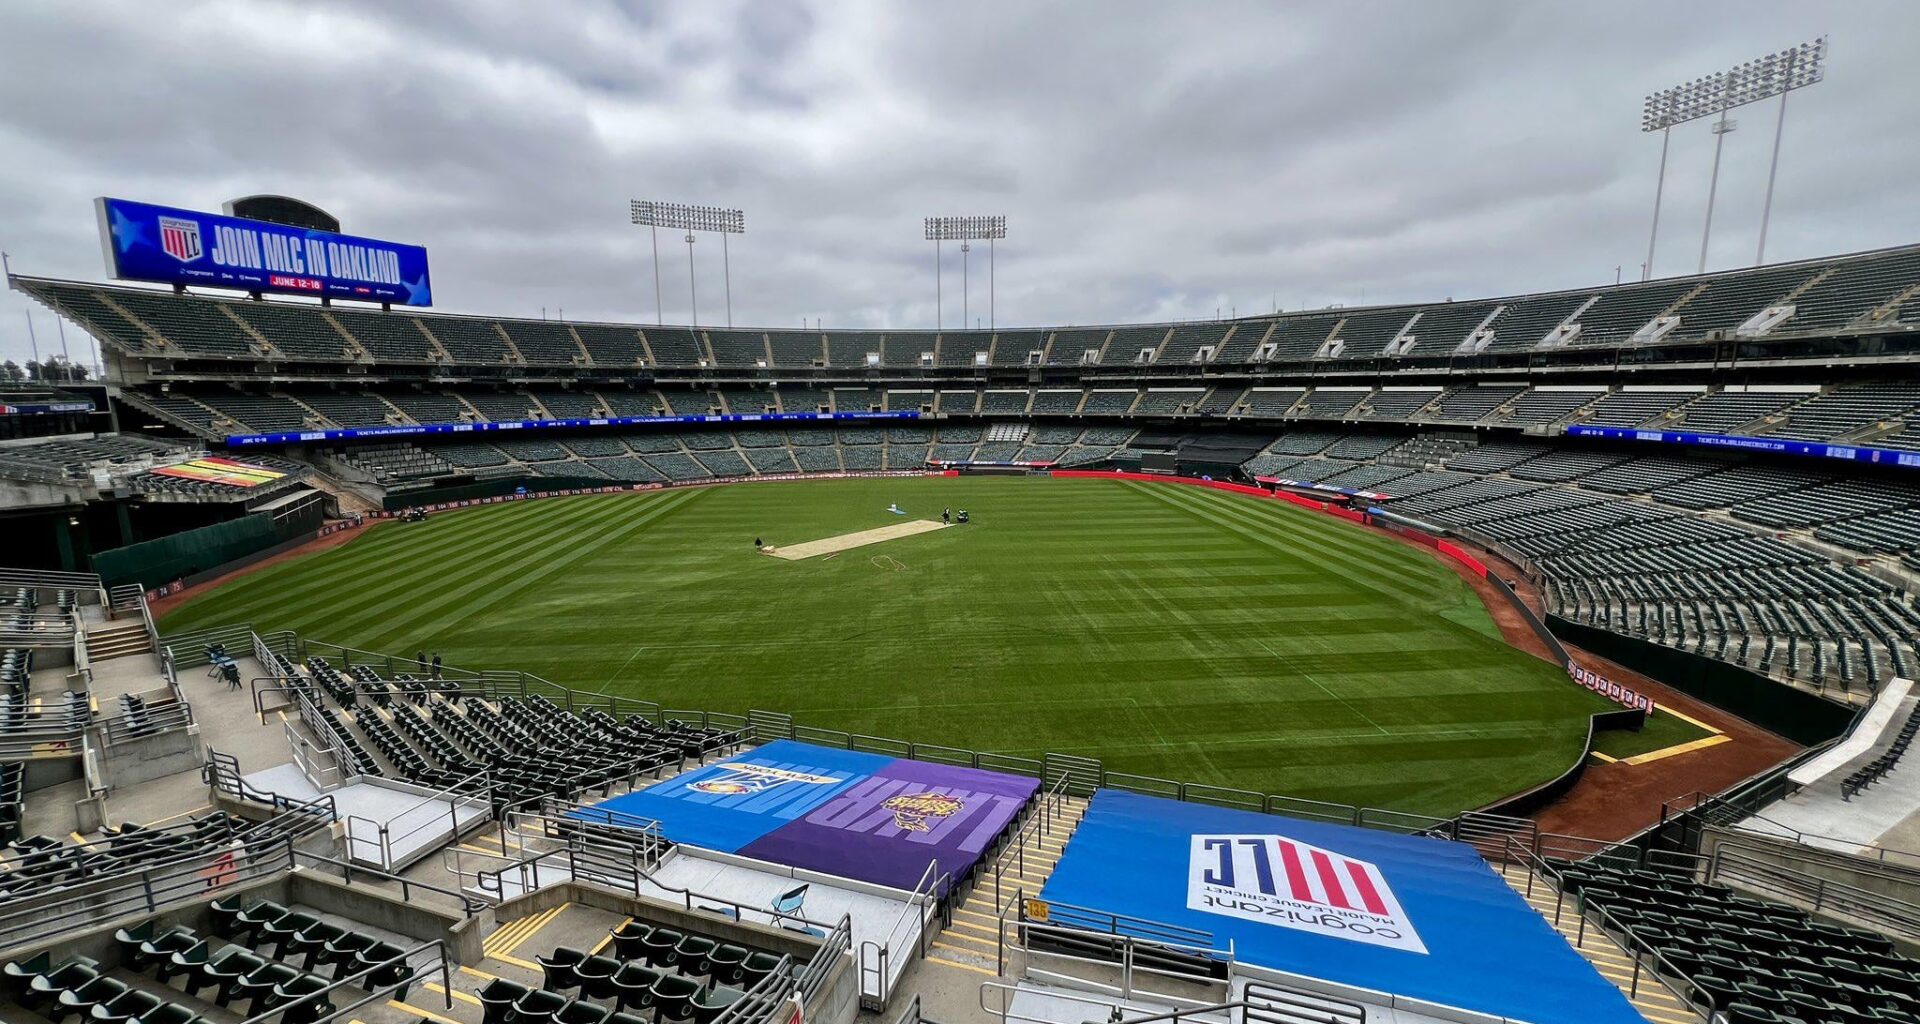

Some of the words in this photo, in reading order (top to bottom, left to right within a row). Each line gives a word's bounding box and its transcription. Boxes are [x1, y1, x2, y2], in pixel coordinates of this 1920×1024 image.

[212, 225, 261, 269] JOIN
[261, 232, 305, 274] MLC
[304, 238, 328, 277] IN
[328, 242, 400, 285] OAKLAND
[273, 277, 295, 287] JUNE
[297, 279, 320, 289] 12-18
[1203, 885, 1267, 901] CRICKET
[1029, 903, 1047, 918] 135
[1271, 895, 1333, 913] LEAGUE
[1203, 894, 1402, 940] cognizant
[1338, 908, 1395, 926] MAJOR
